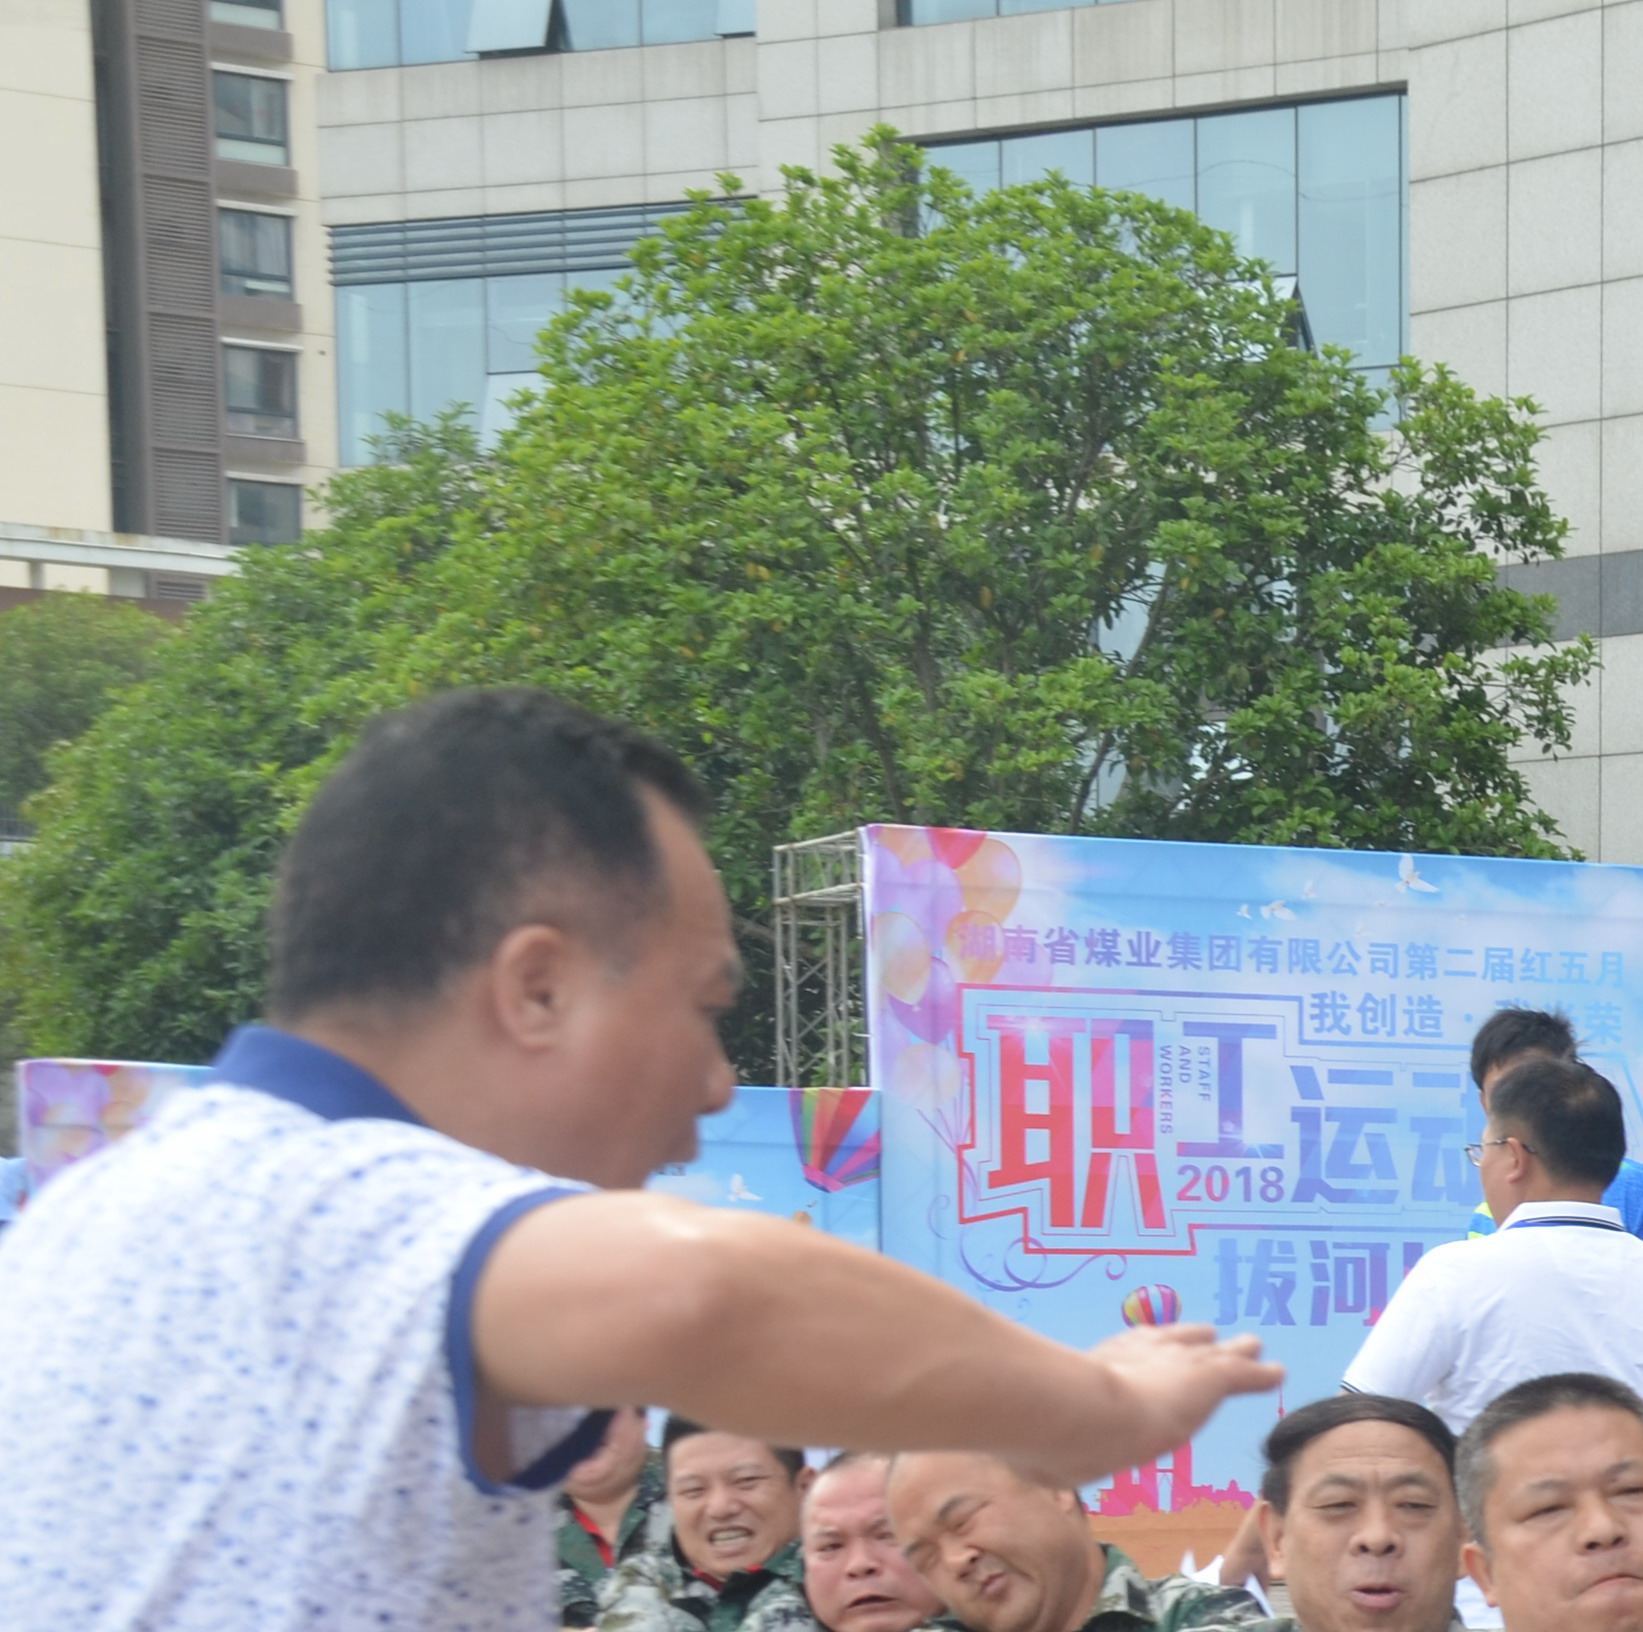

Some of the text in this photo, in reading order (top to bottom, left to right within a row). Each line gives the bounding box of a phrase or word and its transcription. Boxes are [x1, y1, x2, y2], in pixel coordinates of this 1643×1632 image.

[956, 922, 1625, 988] 湖南省煤业集团有限公司第二届红五月
[1159, 1045, 1173, 1134] WORKERS
[1178, 1045, 1192, 1083] AND
[1198, 1046, 1211, 1101] STAFF
[1176, 1164, 1285, 1203] 2018
